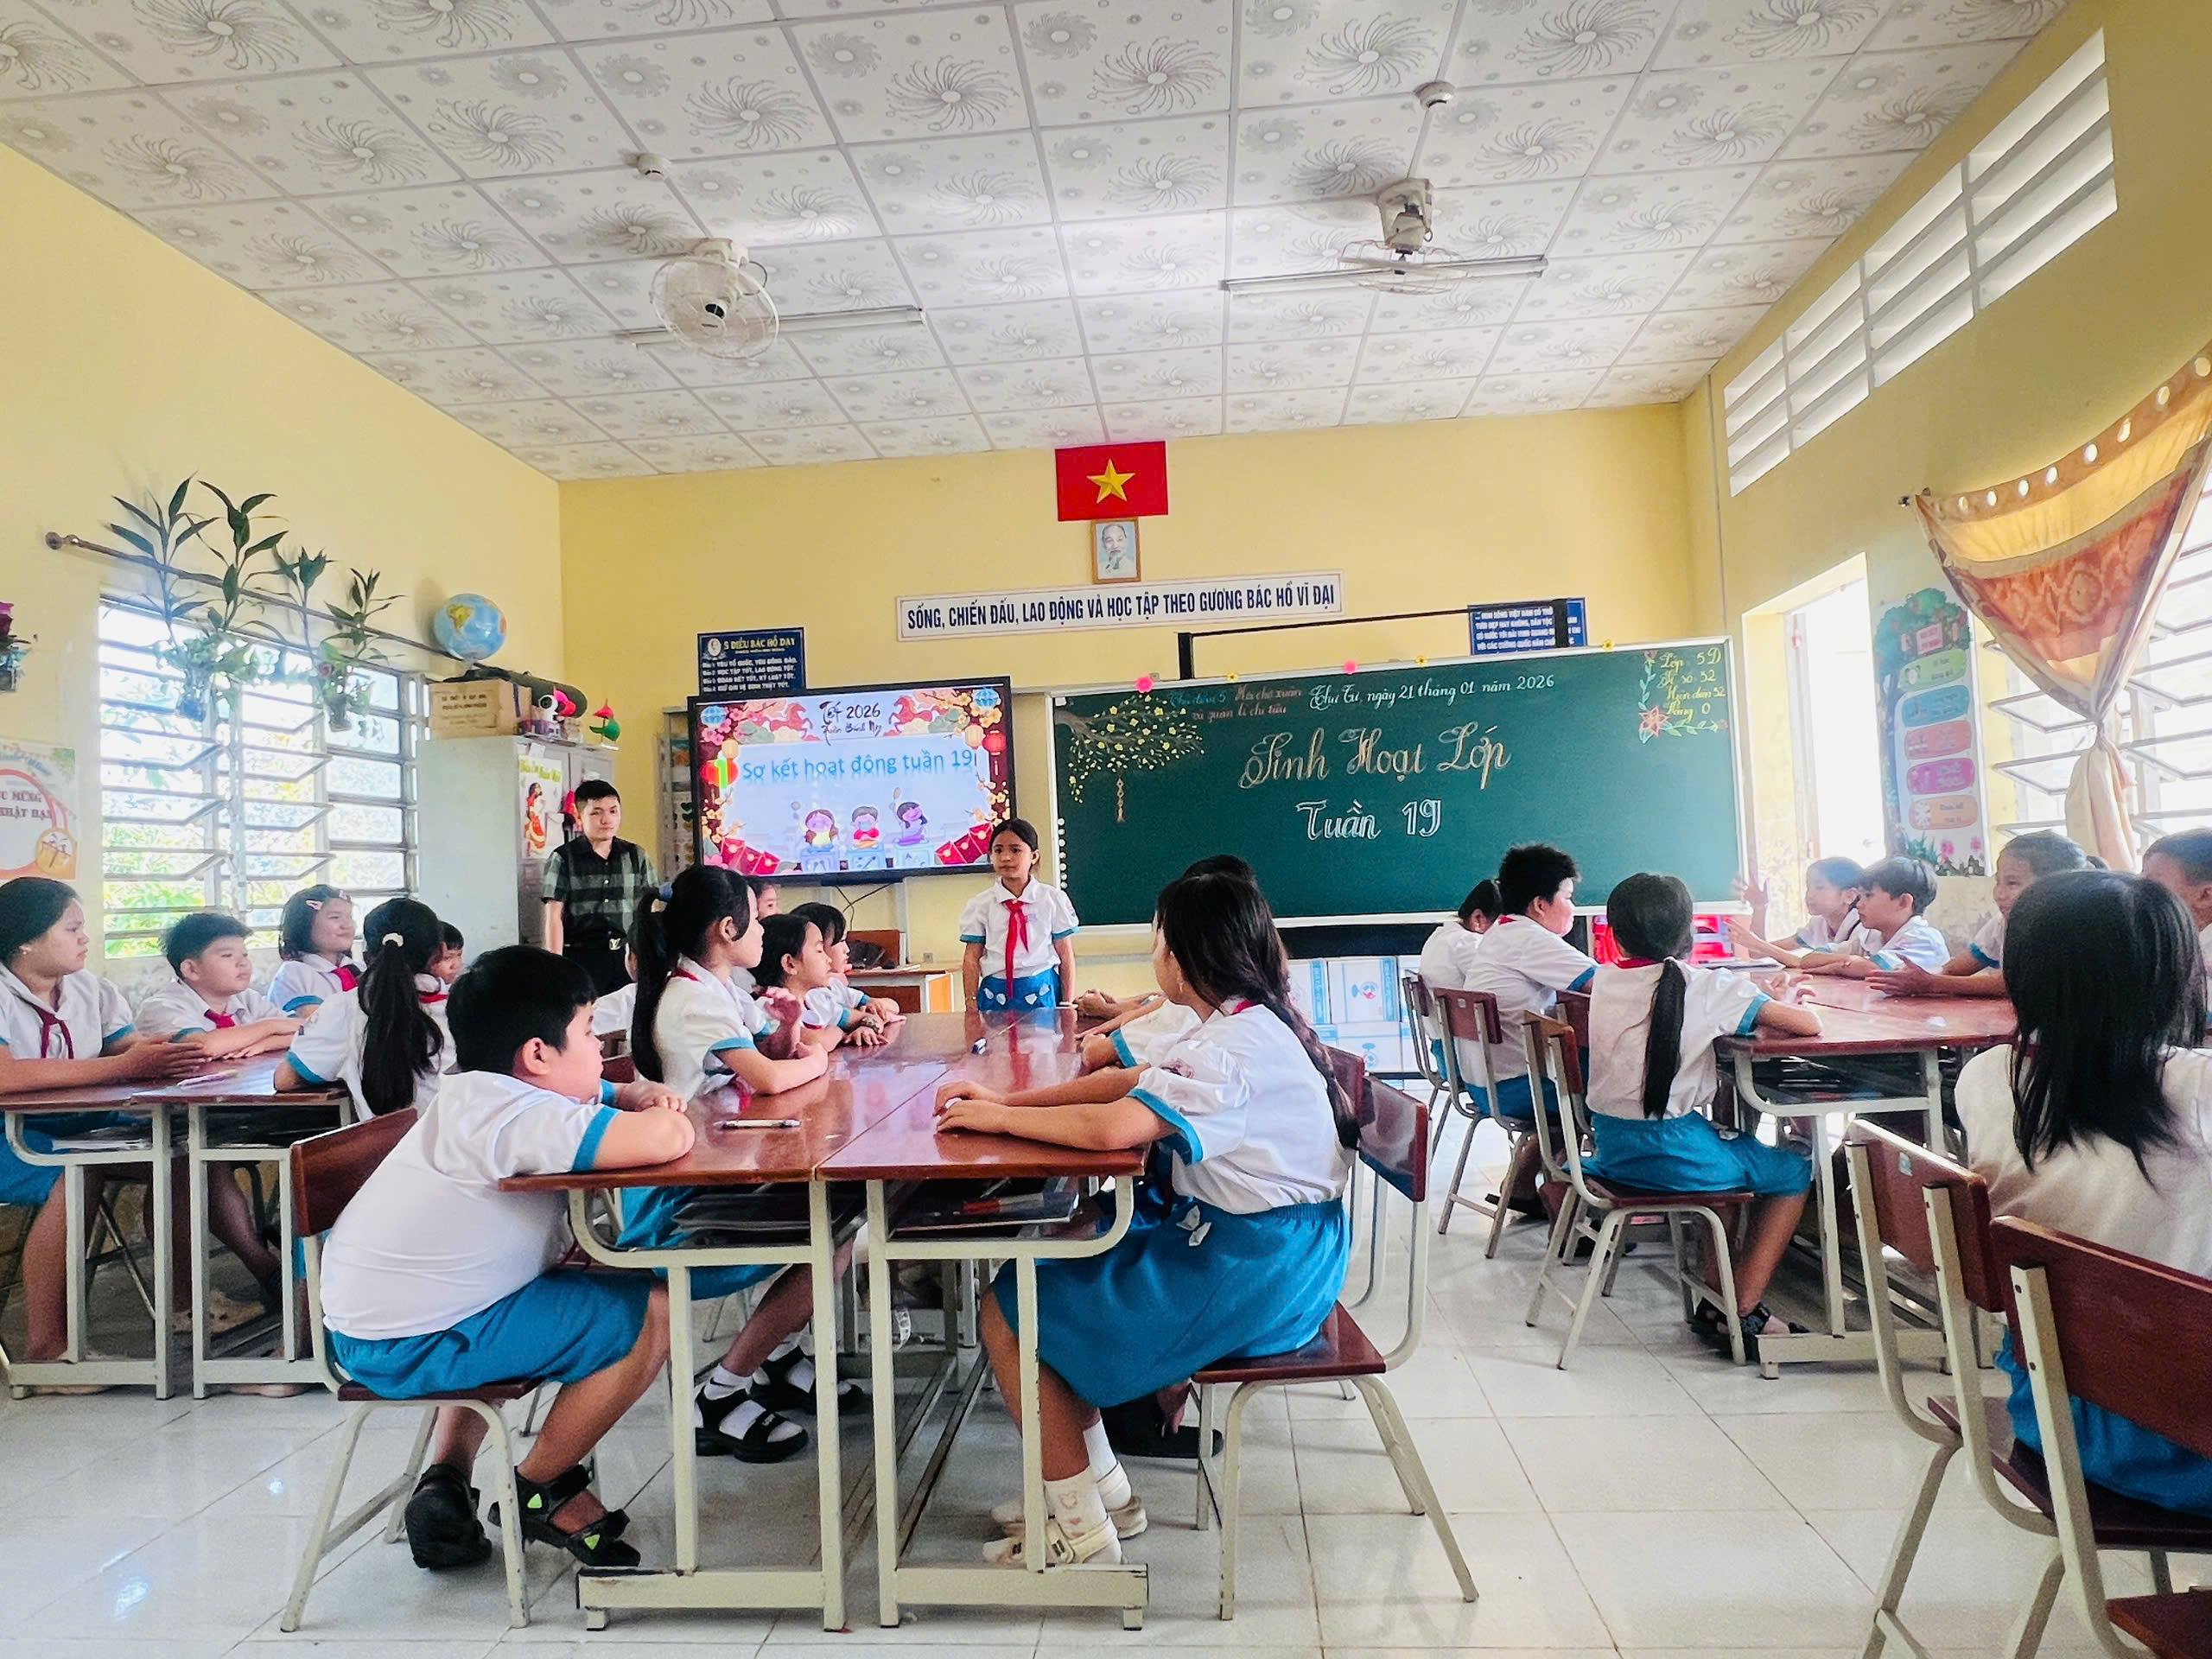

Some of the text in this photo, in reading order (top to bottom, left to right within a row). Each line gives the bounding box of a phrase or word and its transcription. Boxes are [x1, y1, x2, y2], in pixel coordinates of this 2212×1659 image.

[907, 581, 1334, 630] SỐNG, CHIẾN ĐẤU, LAO ĐỘNG VÀ HỌC TẬP THEO GƯƠNG BÁC HỒ VĨ ĐẠI
[731, 636, 749, 650] ĐIỀU
[750, 638, 766, 648] BÁC
[767, 634, 779, 647] HỒ
[779, 637, 795, 648] DẠY
[1368, 688, 1395, 709] ngày
[1398, 684, 1414, 700] 21
[1418, 677, 1456, 706] tháng
[1460, 681, 1475, 695] 01
[1482, 680, 1510, 693] năm
[1516, 674, 1554, 690] 2026
[846, 702, 880, 719] 2026
[1701, 702, 1712, 715] 0
[743, 749, 972, 779] Sơ kết hoạt động tuần 19
[1238, 721, 1511, 791] Sinh Hoạt Lớp
[1295, 798, 1442, 841] Tuần 19
